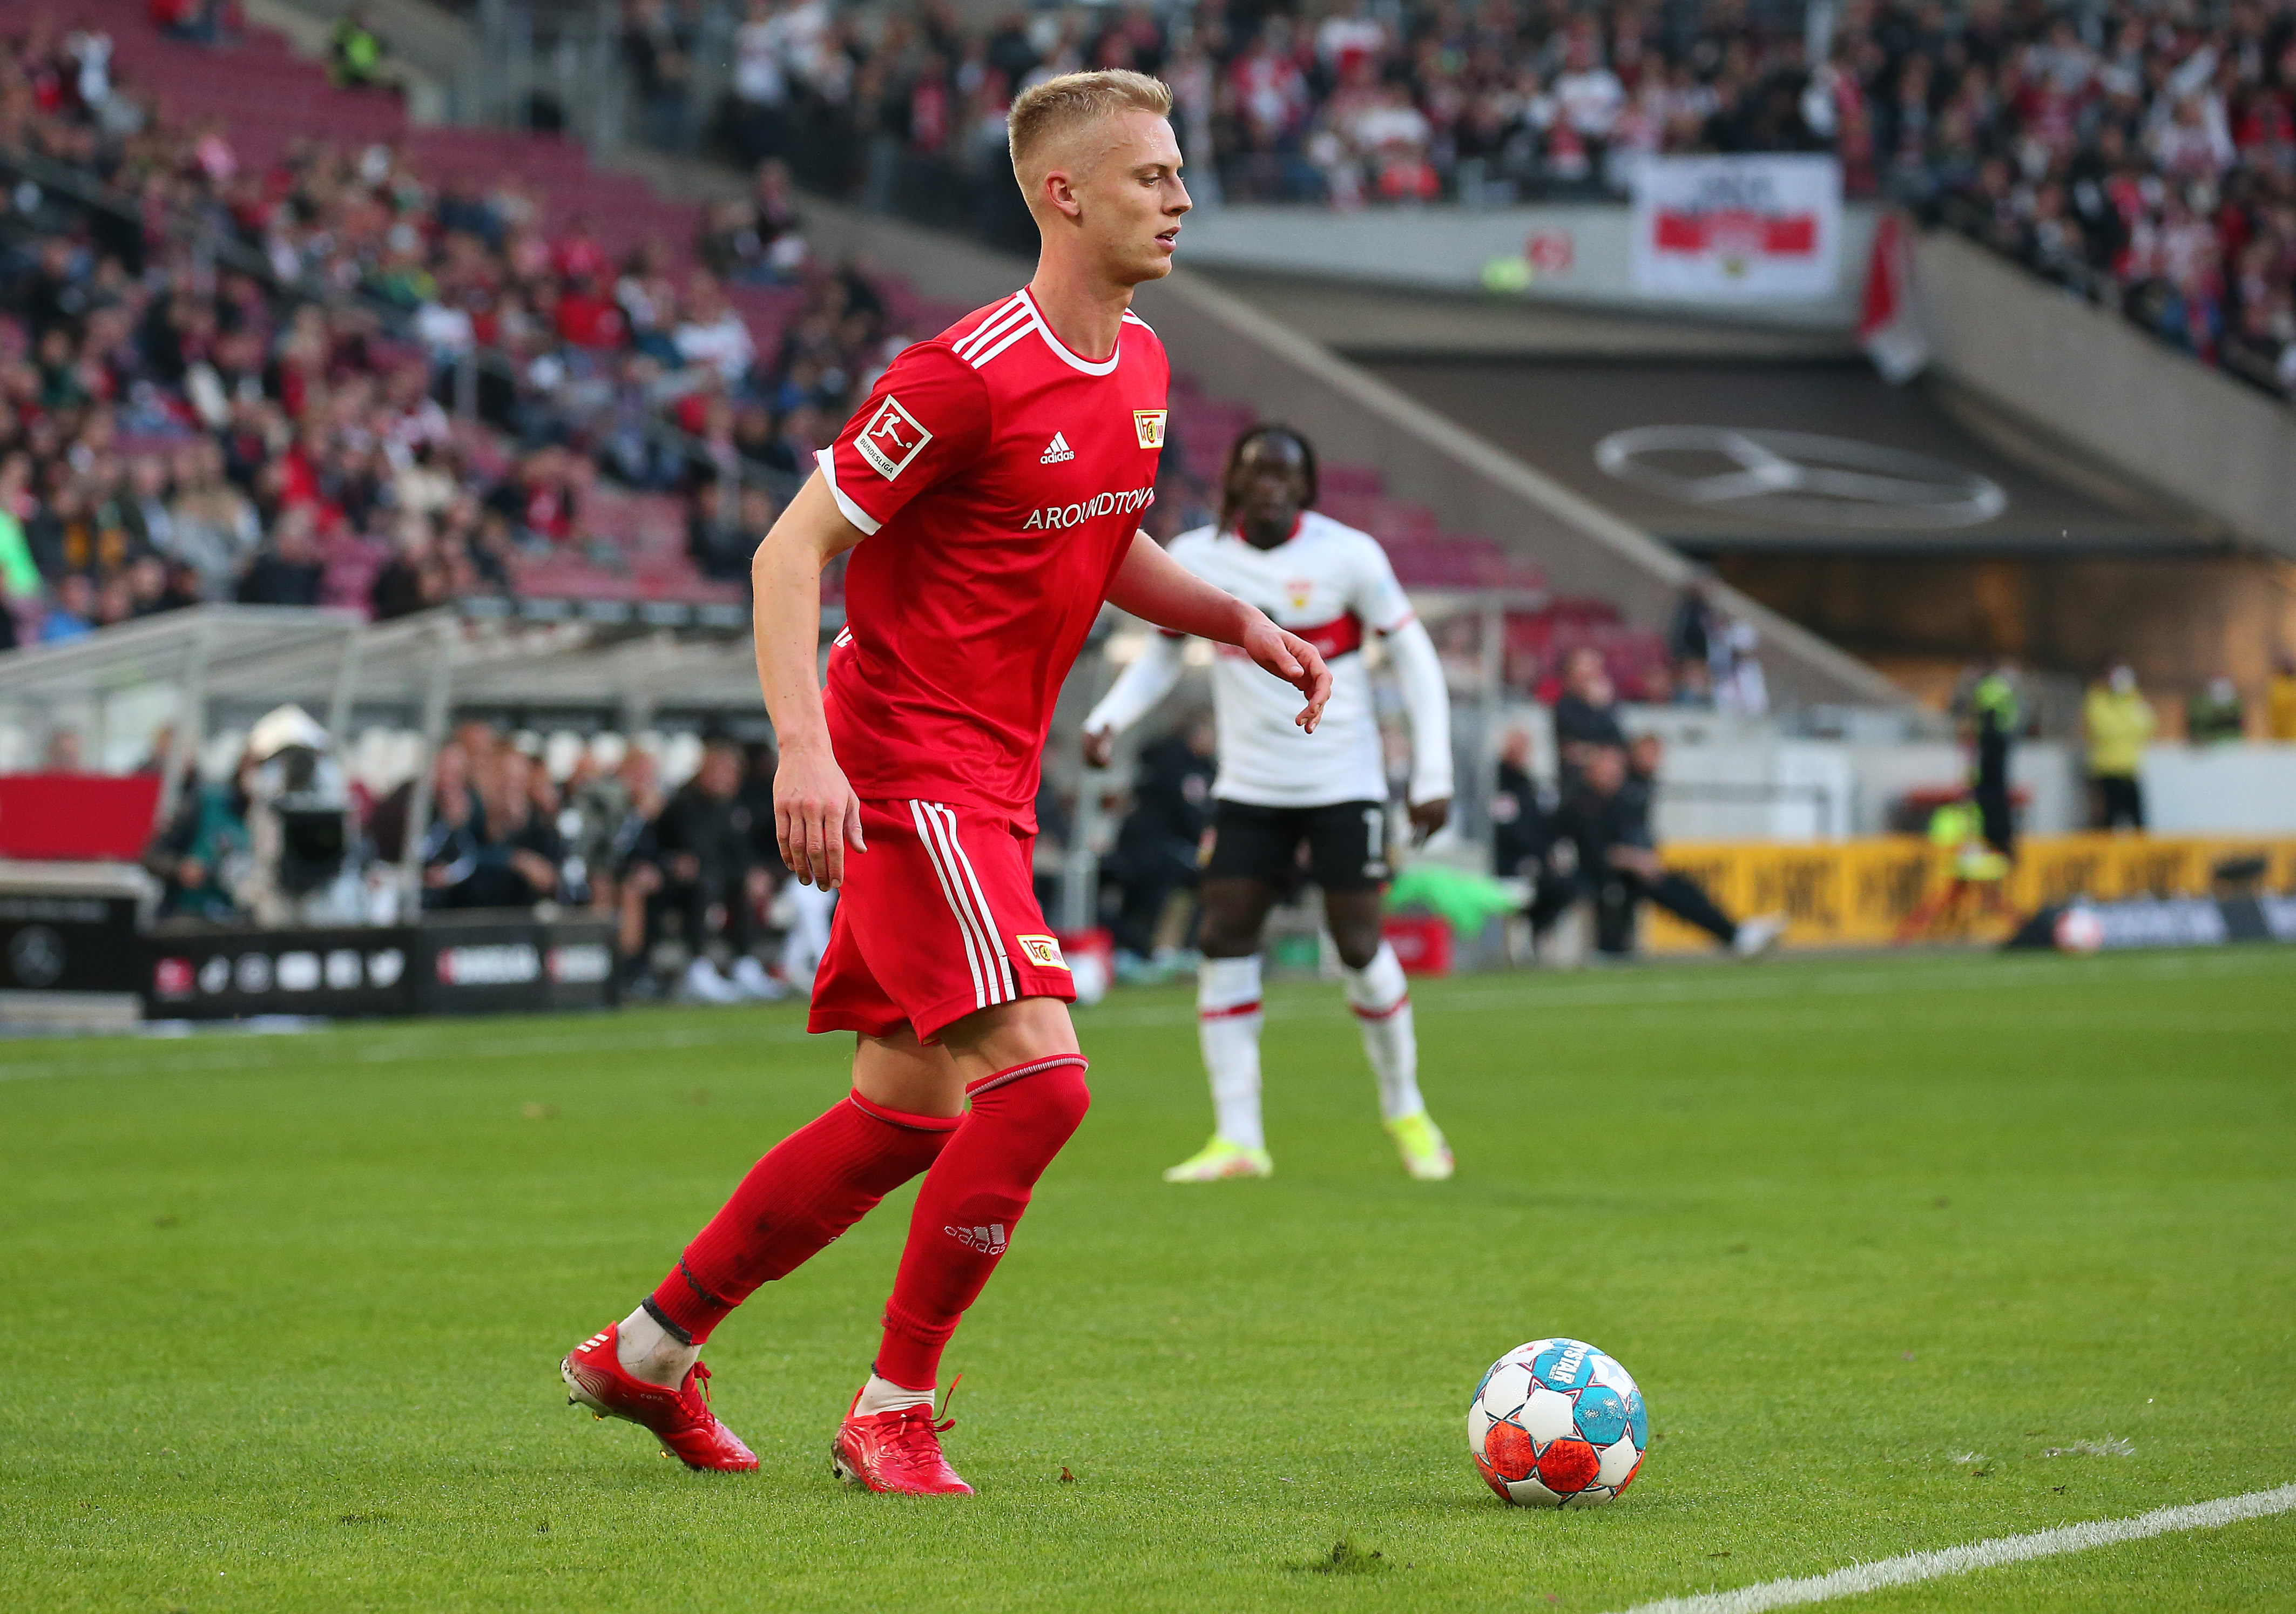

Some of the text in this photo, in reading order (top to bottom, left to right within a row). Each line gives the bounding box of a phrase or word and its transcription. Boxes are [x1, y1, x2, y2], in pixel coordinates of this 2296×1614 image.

[860, 438, 894, 474] BUNDESLIGA
[1040, 450, 1075, 464] adidas
[944, 1226, 1007, 1255] adidas
[640, 1393, 663, 1401] COPA
